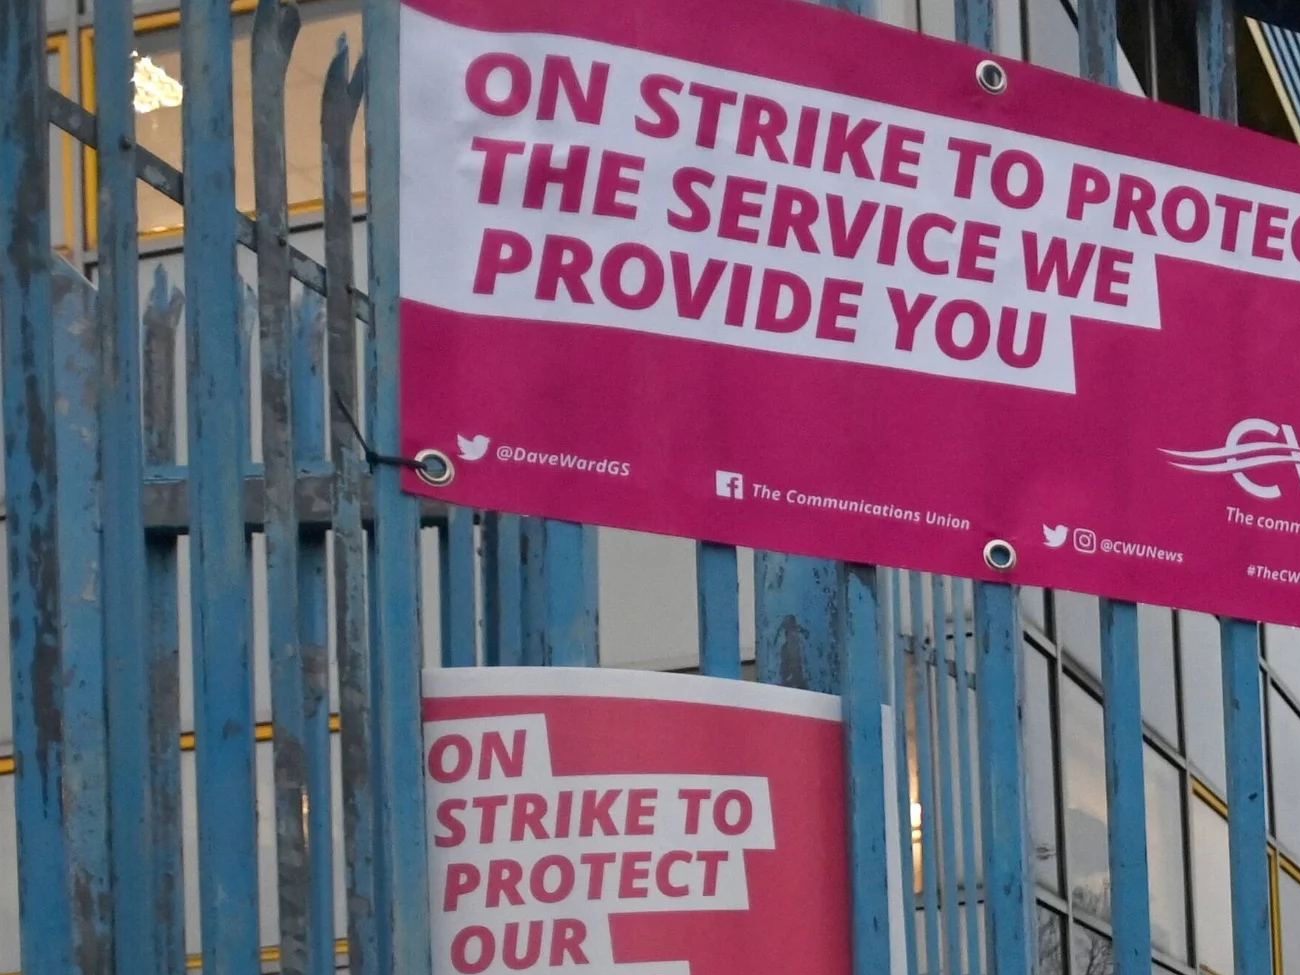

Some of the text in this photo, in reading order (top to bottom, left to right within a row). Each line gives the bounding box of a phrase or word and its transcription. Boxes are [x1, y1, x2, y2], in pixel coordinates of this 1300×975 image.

[465, 52, 610, 125] ON
[634, 73, 925, 189] STRIKE
[947, 137, 1043, 209] TO
[471, 137, 1134, 306] THE SERVICE WE
[472, 228, 1046, 368] PROVIDE YOU
[496, 445, 630, 477] @DaveWardGS
[752, 484, 971, 531] The Communications Union
[1226, 506, 1254, 527] The
[1100, 539, 1183, 563] @CWUNews
[428, 729, 527, 783] ON
[434, 788, 752, 848] STRIKE TO
[443, 850, 728, 912] PROTECT
[450, 918, 590, 975] OUR
